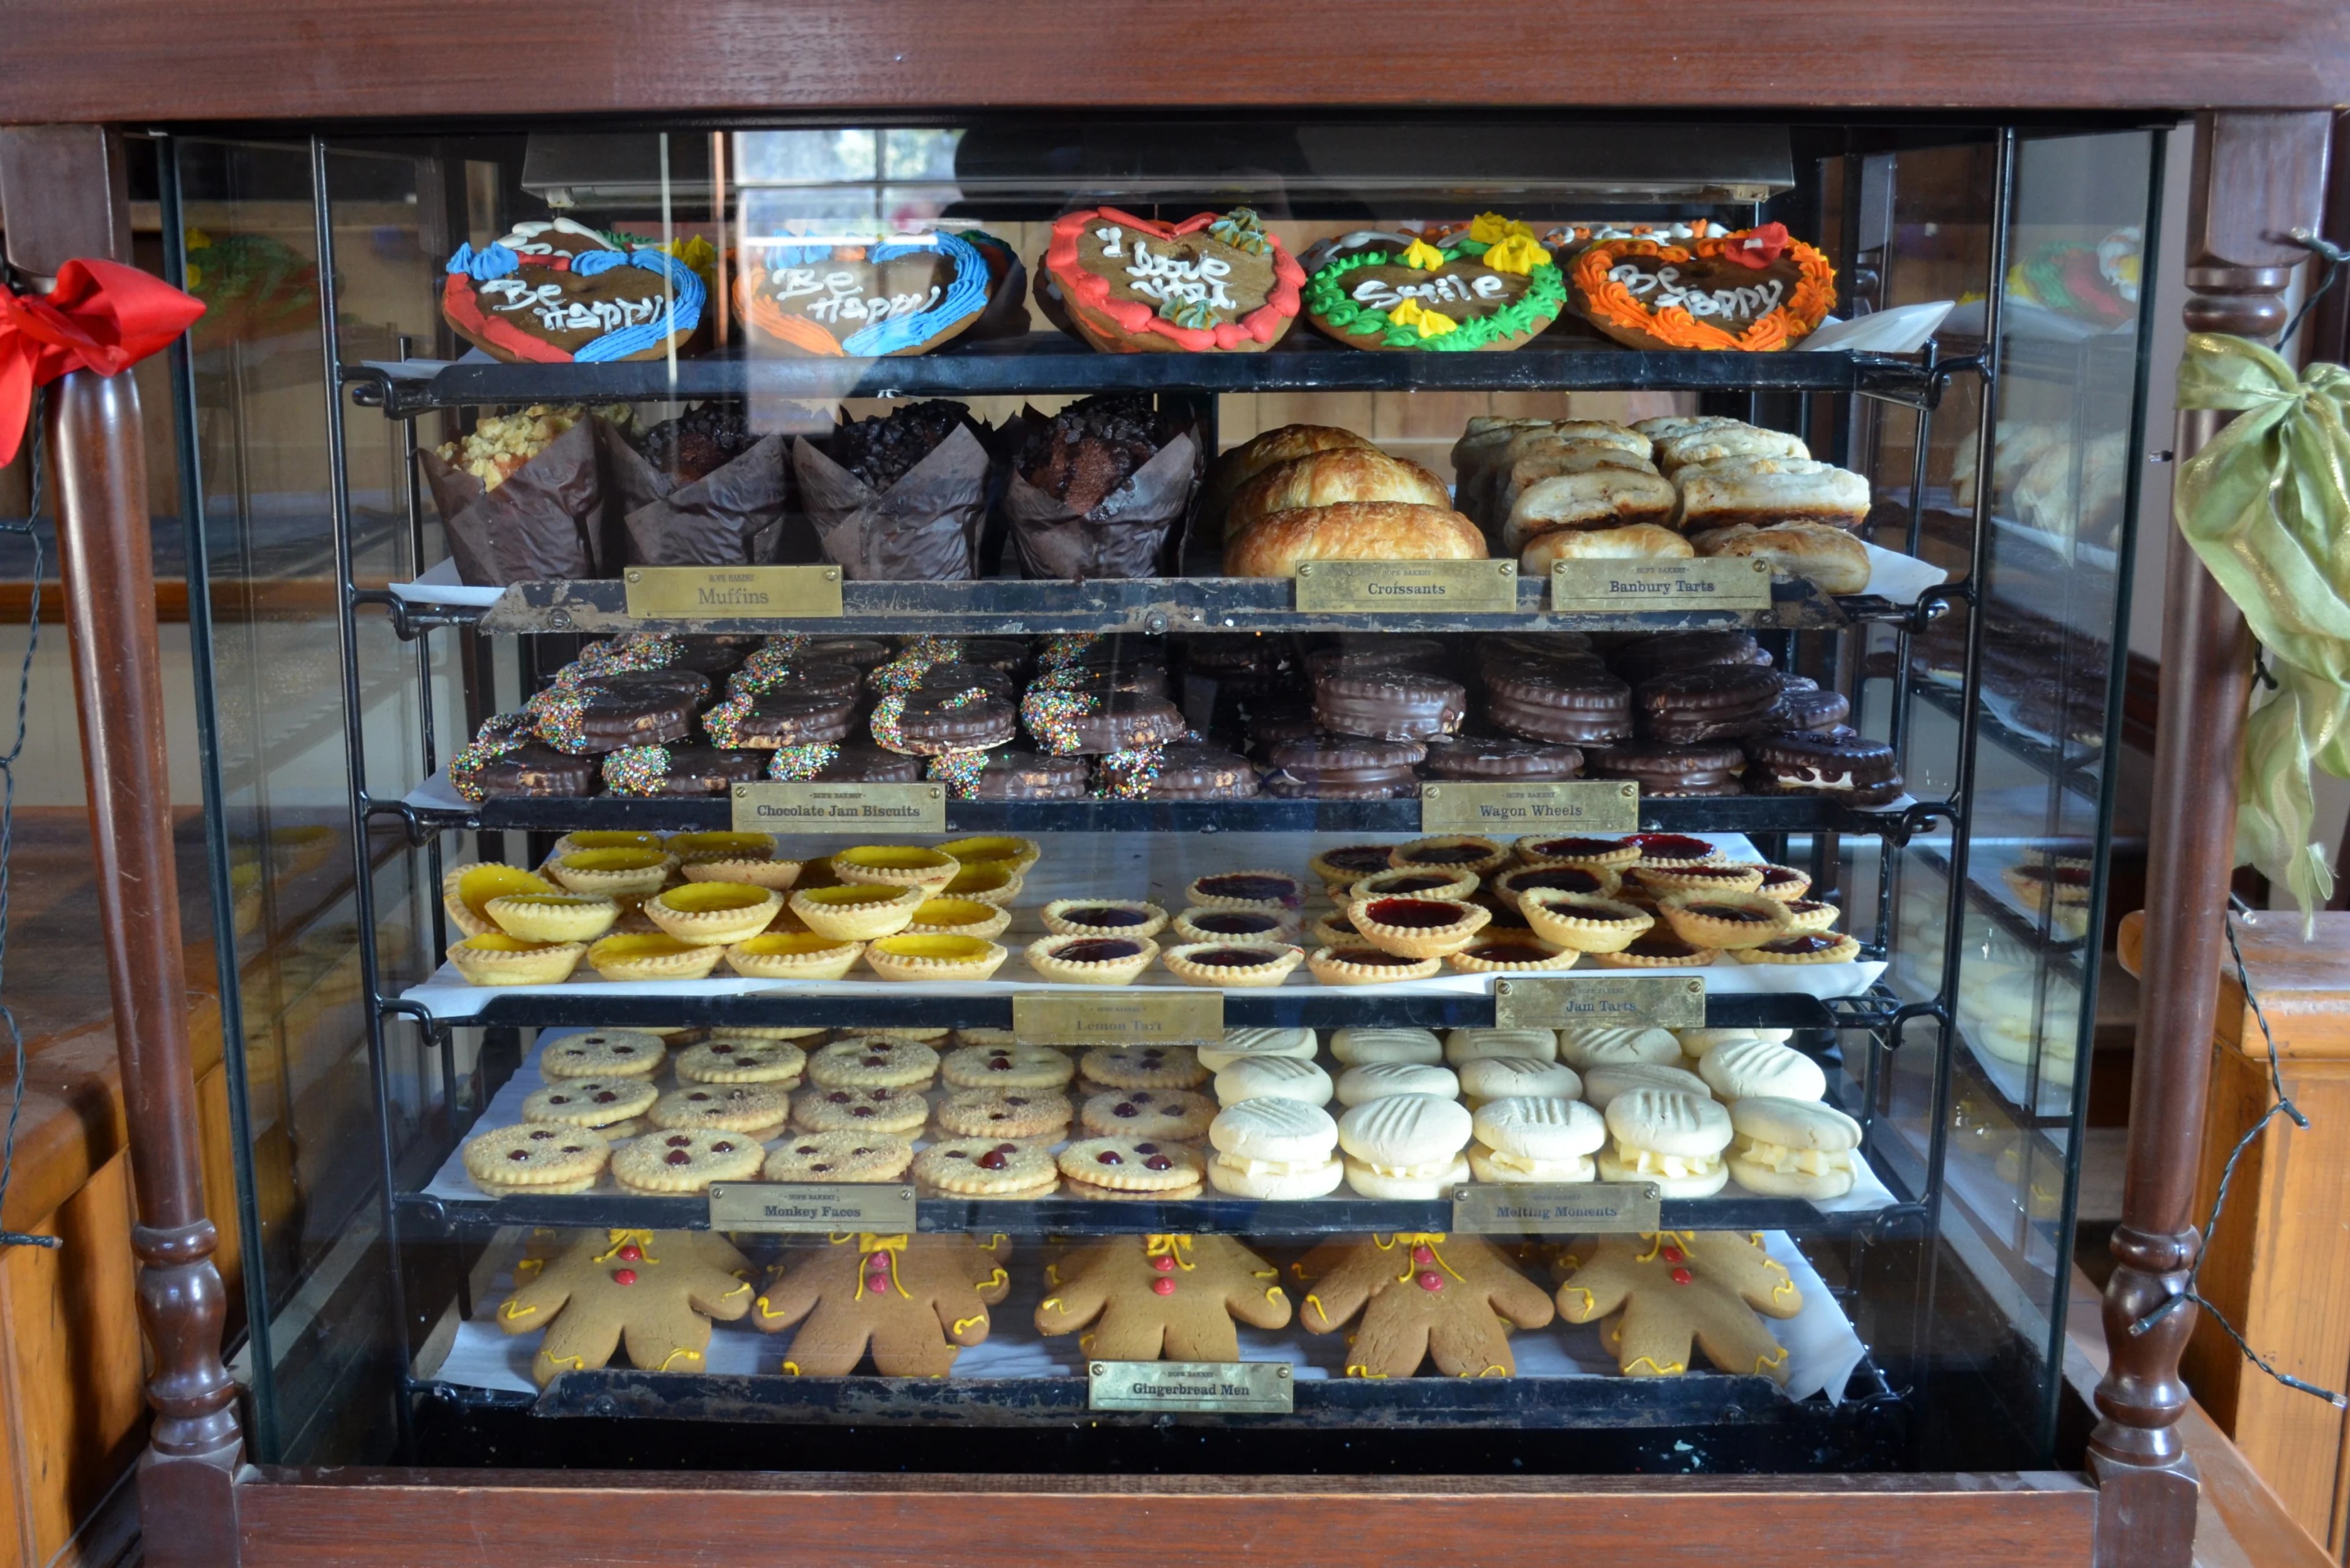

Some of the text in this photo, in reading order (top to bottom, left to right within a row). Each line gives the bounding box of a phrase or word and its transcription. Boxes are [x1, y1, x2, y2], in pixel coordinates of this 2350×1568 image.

[772, 268, 864, 301] Be
[1352, 274, 1509, 309] Smile
[479, 278, 567, 310] Be
[1368, 582, 1445, 595] Croissants
[1610, 580, 1714, 595] Banbury Tarts
[698, 588, 769, 604] Muffins
[757, 805, 920, 817] Chocolate Jam Biscuits
[1479, 805, 1582, 819] Wagon Wheels
[1566, 1000, 1636, 1012] Jam Tarts
[1076, 1020, 1162, 1031] Lemon Tart
[764, 1206, 861, 1219] Monkey Faces
[1496, 1206, 1617, 1220] Melting Moments
[1133, 1383, 1250, 1397] Gingerbread Men
